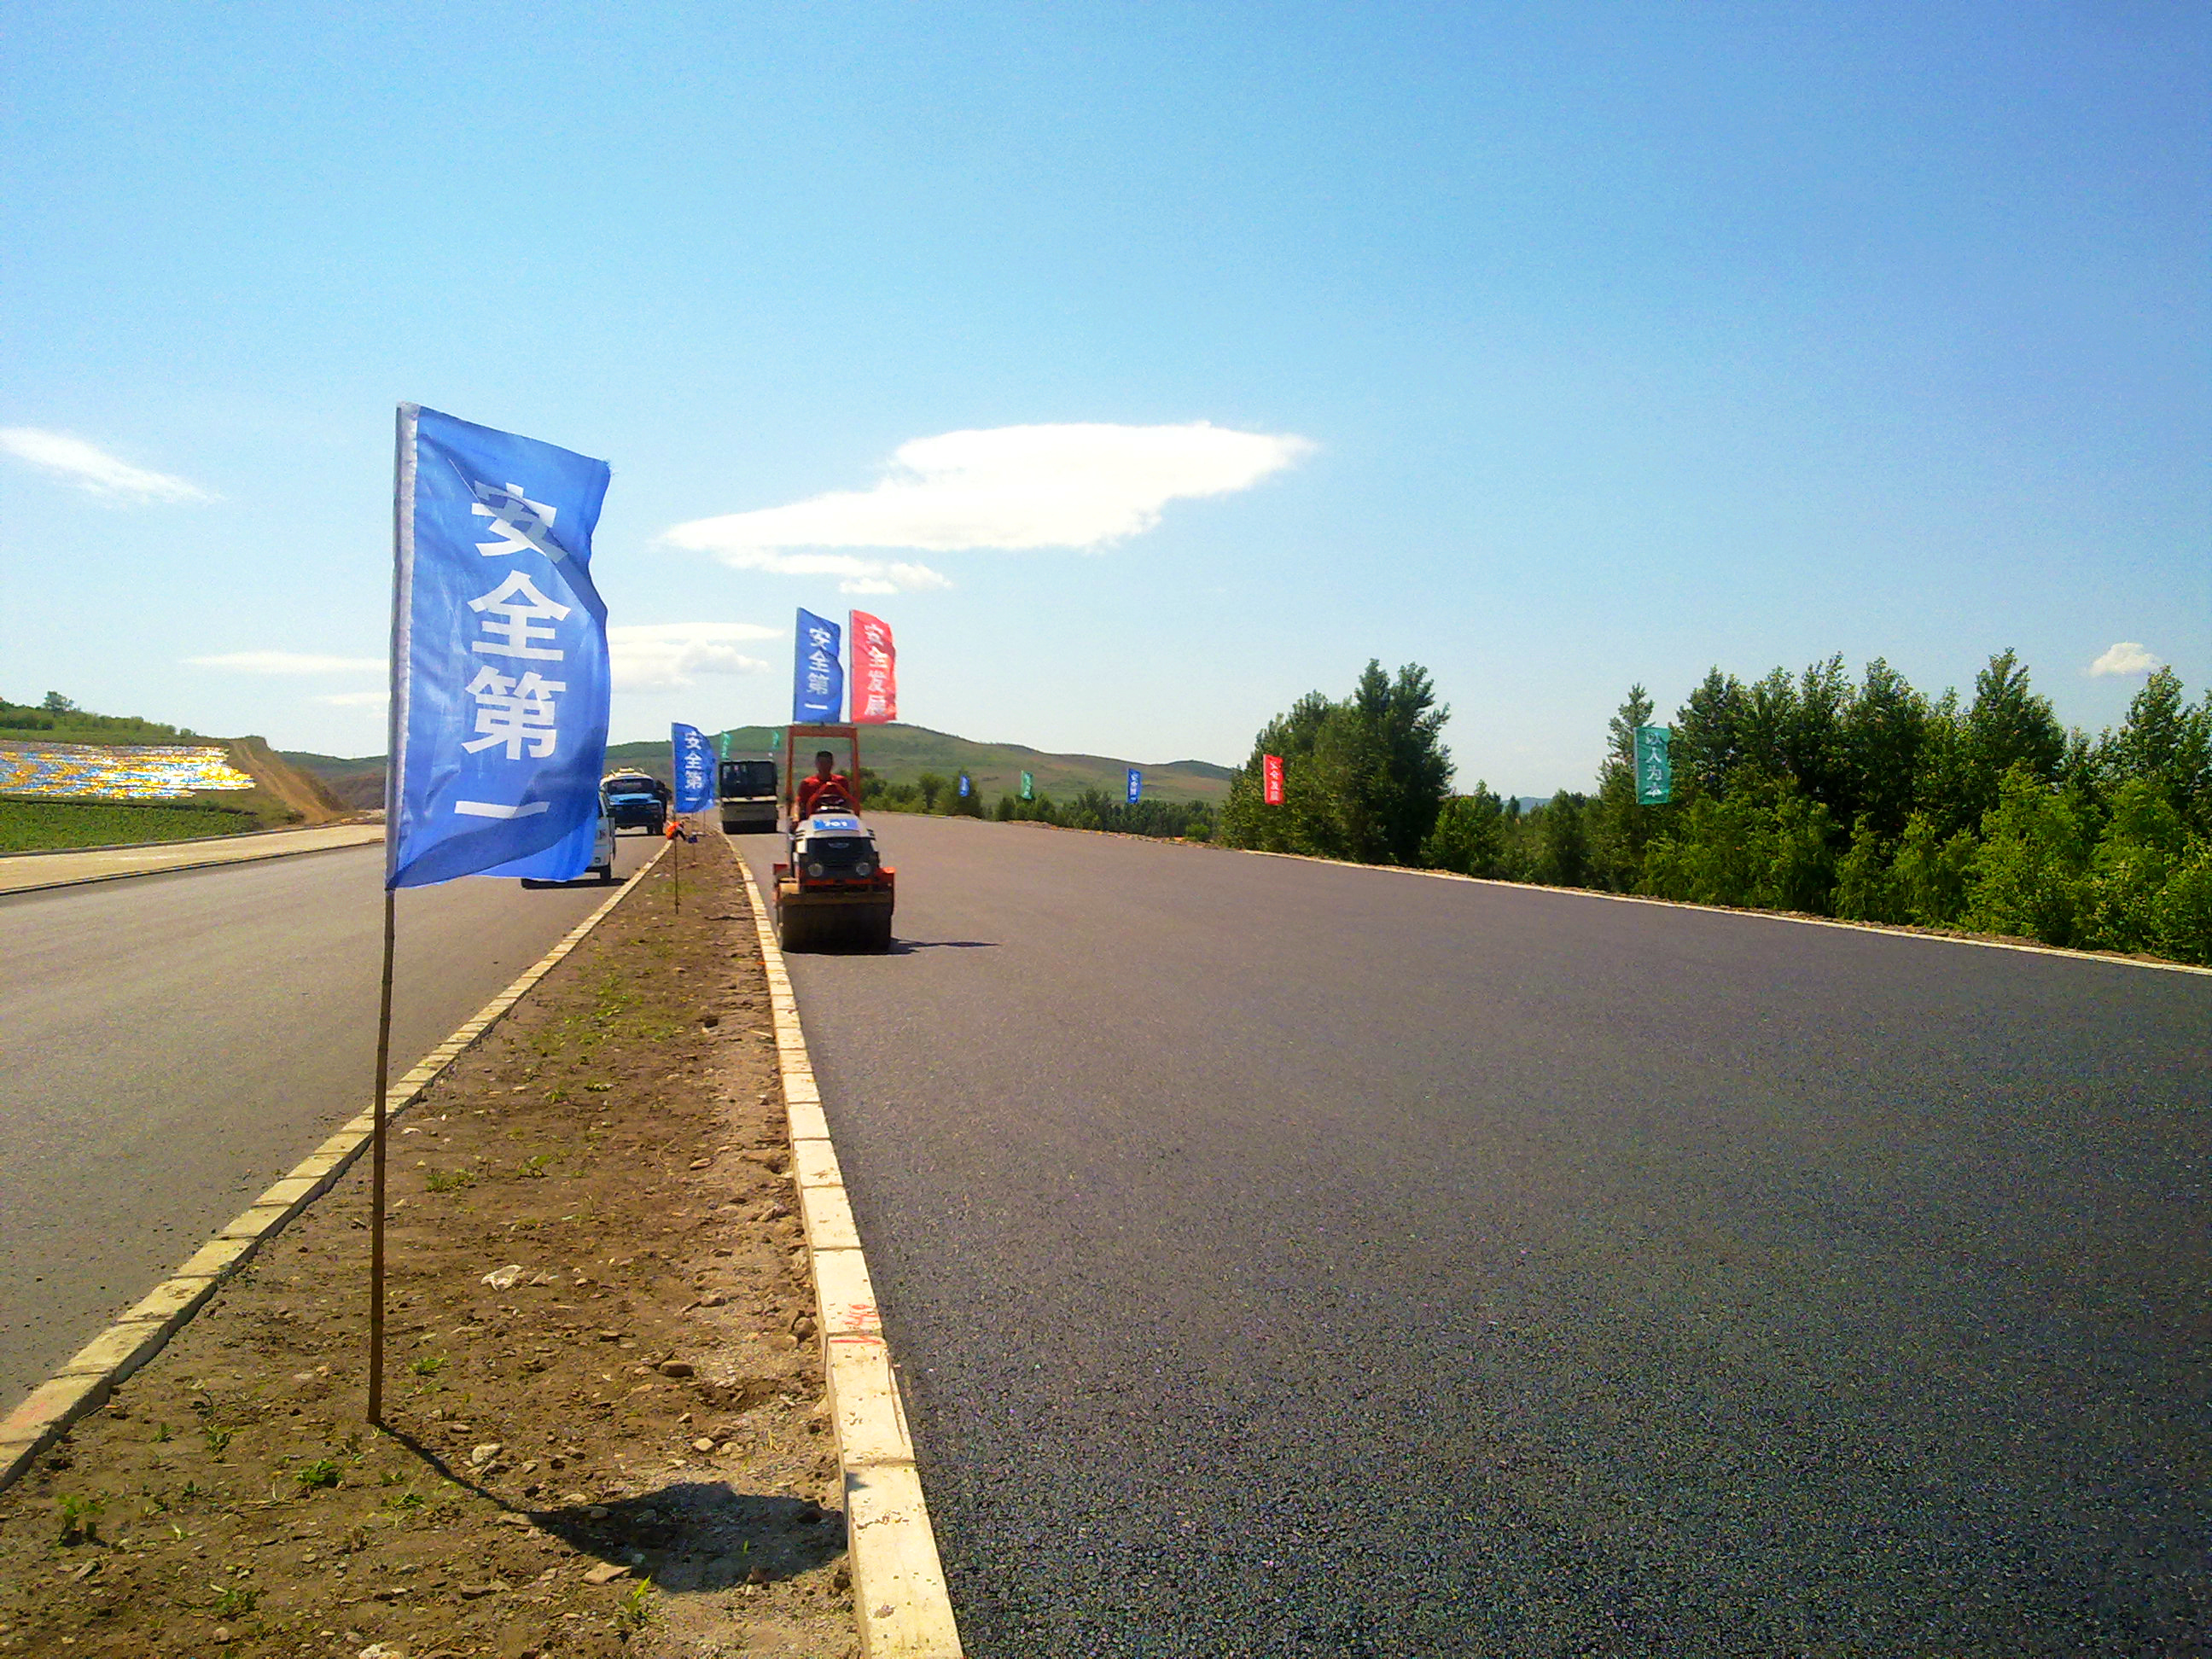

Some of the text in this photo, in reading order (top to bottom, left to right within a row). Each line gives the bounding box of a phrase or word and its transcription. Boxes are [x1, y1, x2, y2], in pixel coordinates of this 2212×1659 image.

[453, 481, 571, 819] 安全第一
[804, 627, 831, 710] 安全第一
[684, 731, 703, 802] 安全第一
[1644, 731, 1662, 798] 以人为本
